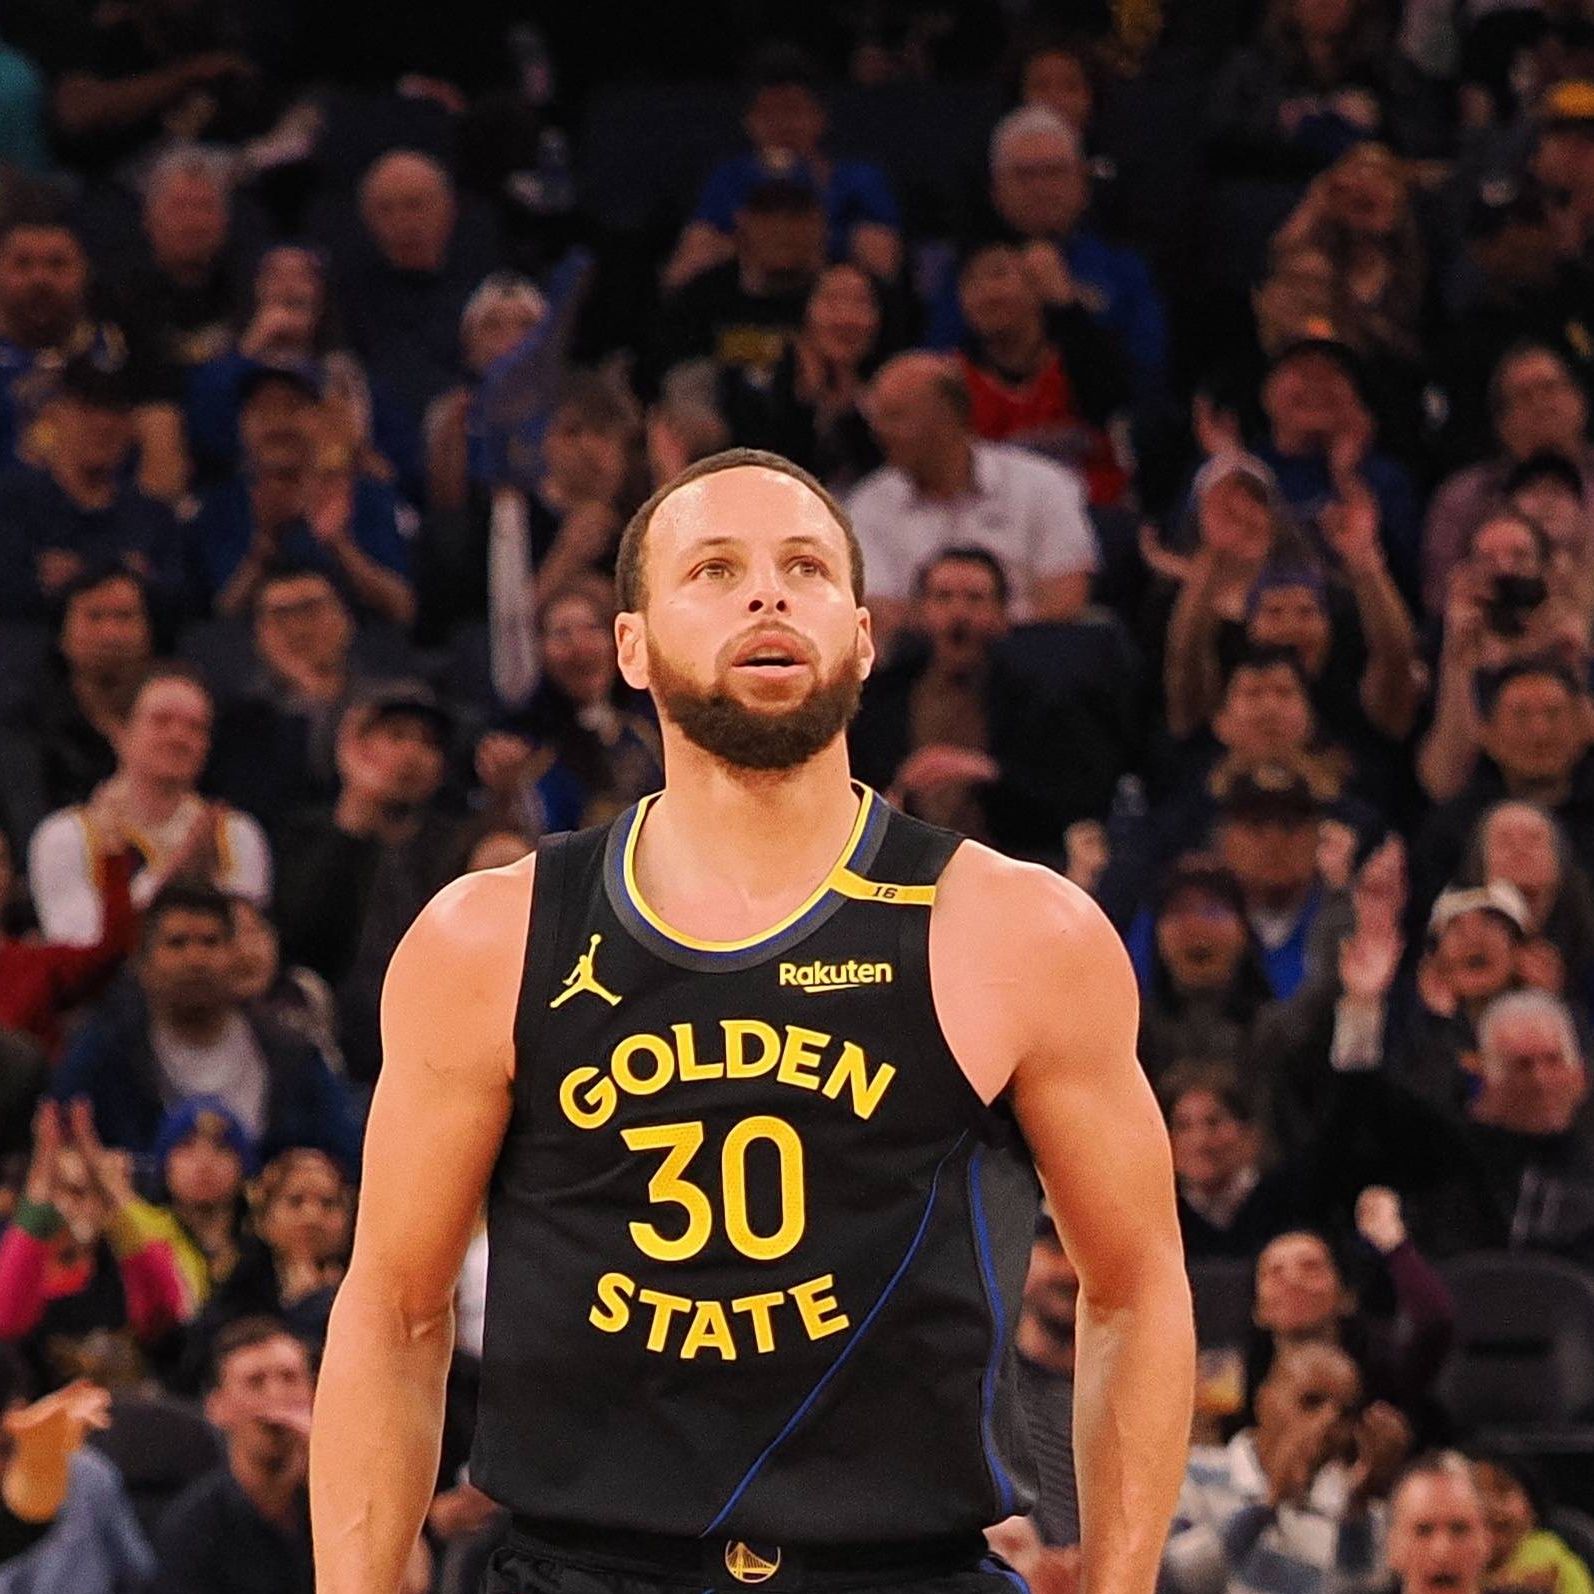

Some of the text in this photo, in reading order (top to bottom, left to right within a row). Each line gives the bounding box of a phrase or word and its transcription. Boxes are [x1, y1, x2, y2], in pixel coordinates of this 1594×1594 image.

[872, 886, 898, 899] 16
[779, 960, 893, 987] Rakuten
[559, 1019, 897, 1130] GOLDEN
[619, 1115, 806, 1262] 30
[588, 1272, 851, 1361] STATE
